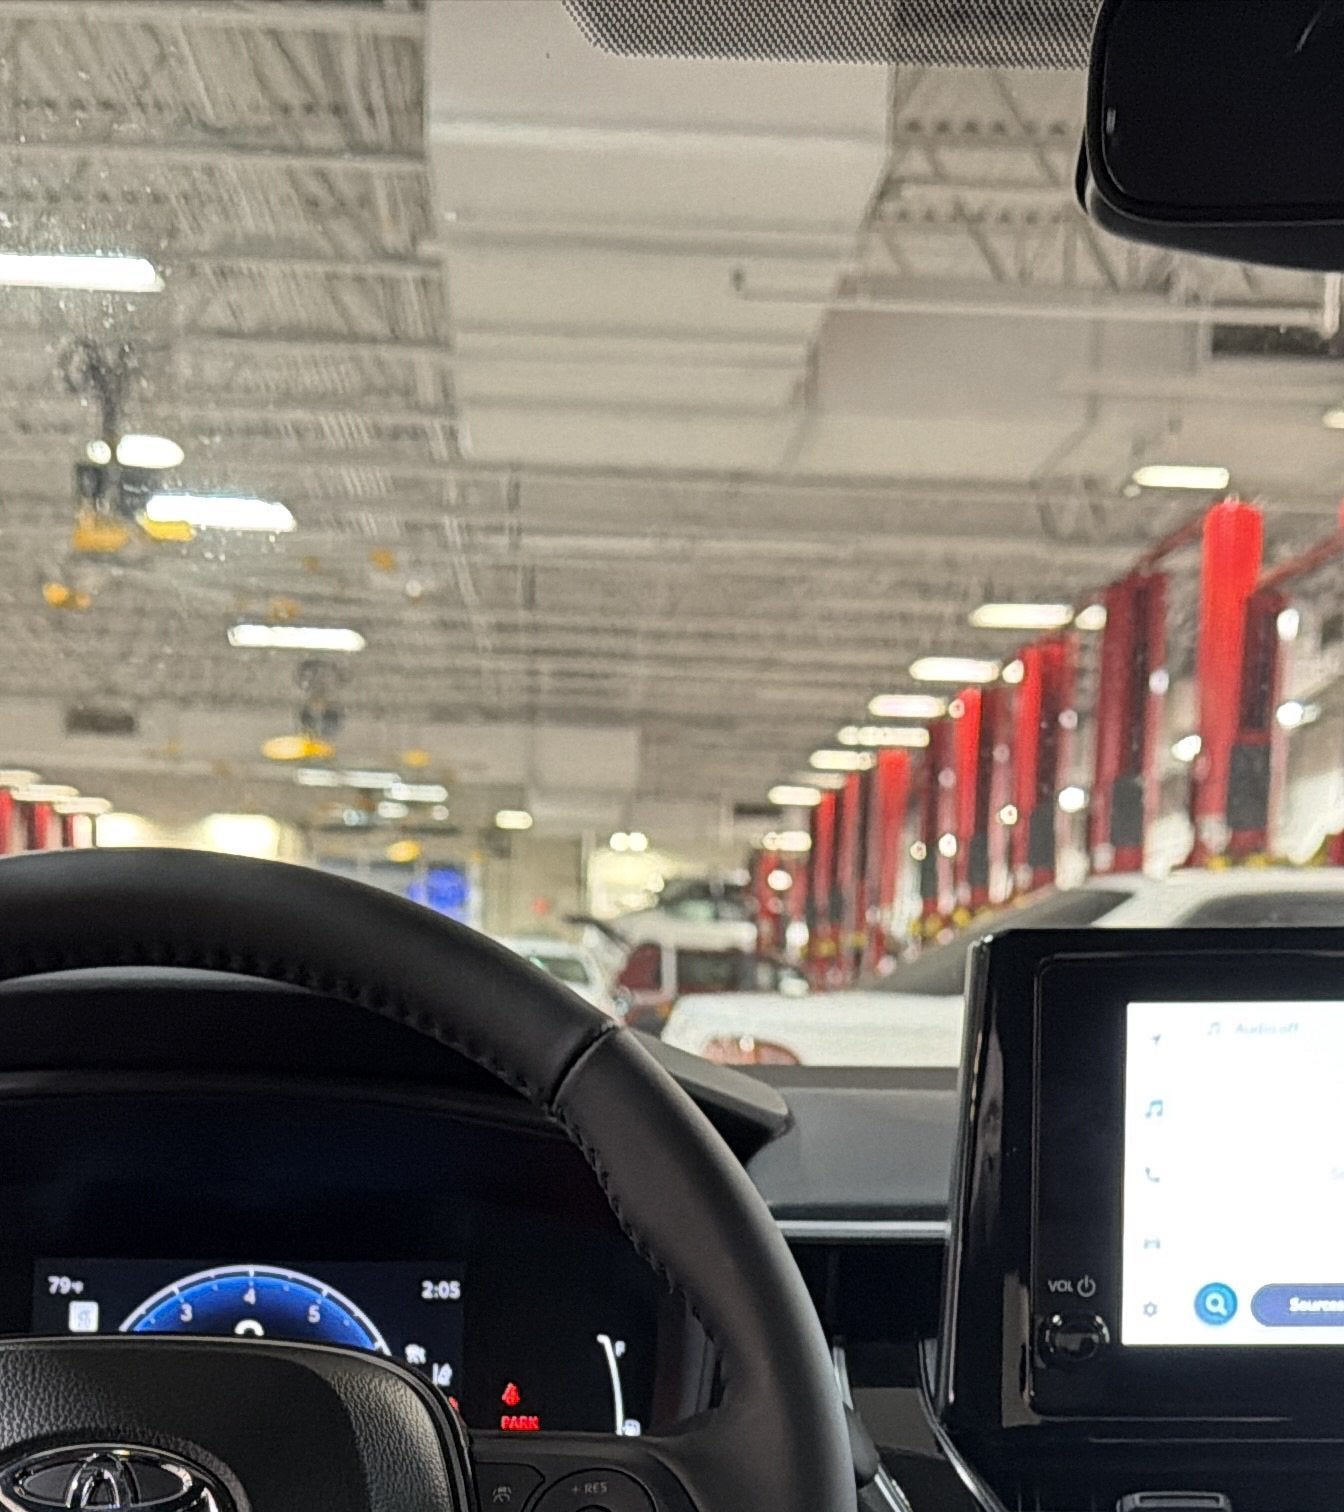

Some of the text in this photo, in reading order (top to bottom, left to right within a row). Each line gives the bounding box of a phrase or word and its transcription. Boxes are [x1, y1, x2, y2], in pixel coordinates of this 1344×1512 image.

[421, 1279, 461, 1300] 2:05
[1048, 1279, 1074, 1293] VOL
[243, 1287, 256, 1305] 4
[179, 1303, 321, 1323] 3 5
[500, 1415, 540, 1431] PARK
